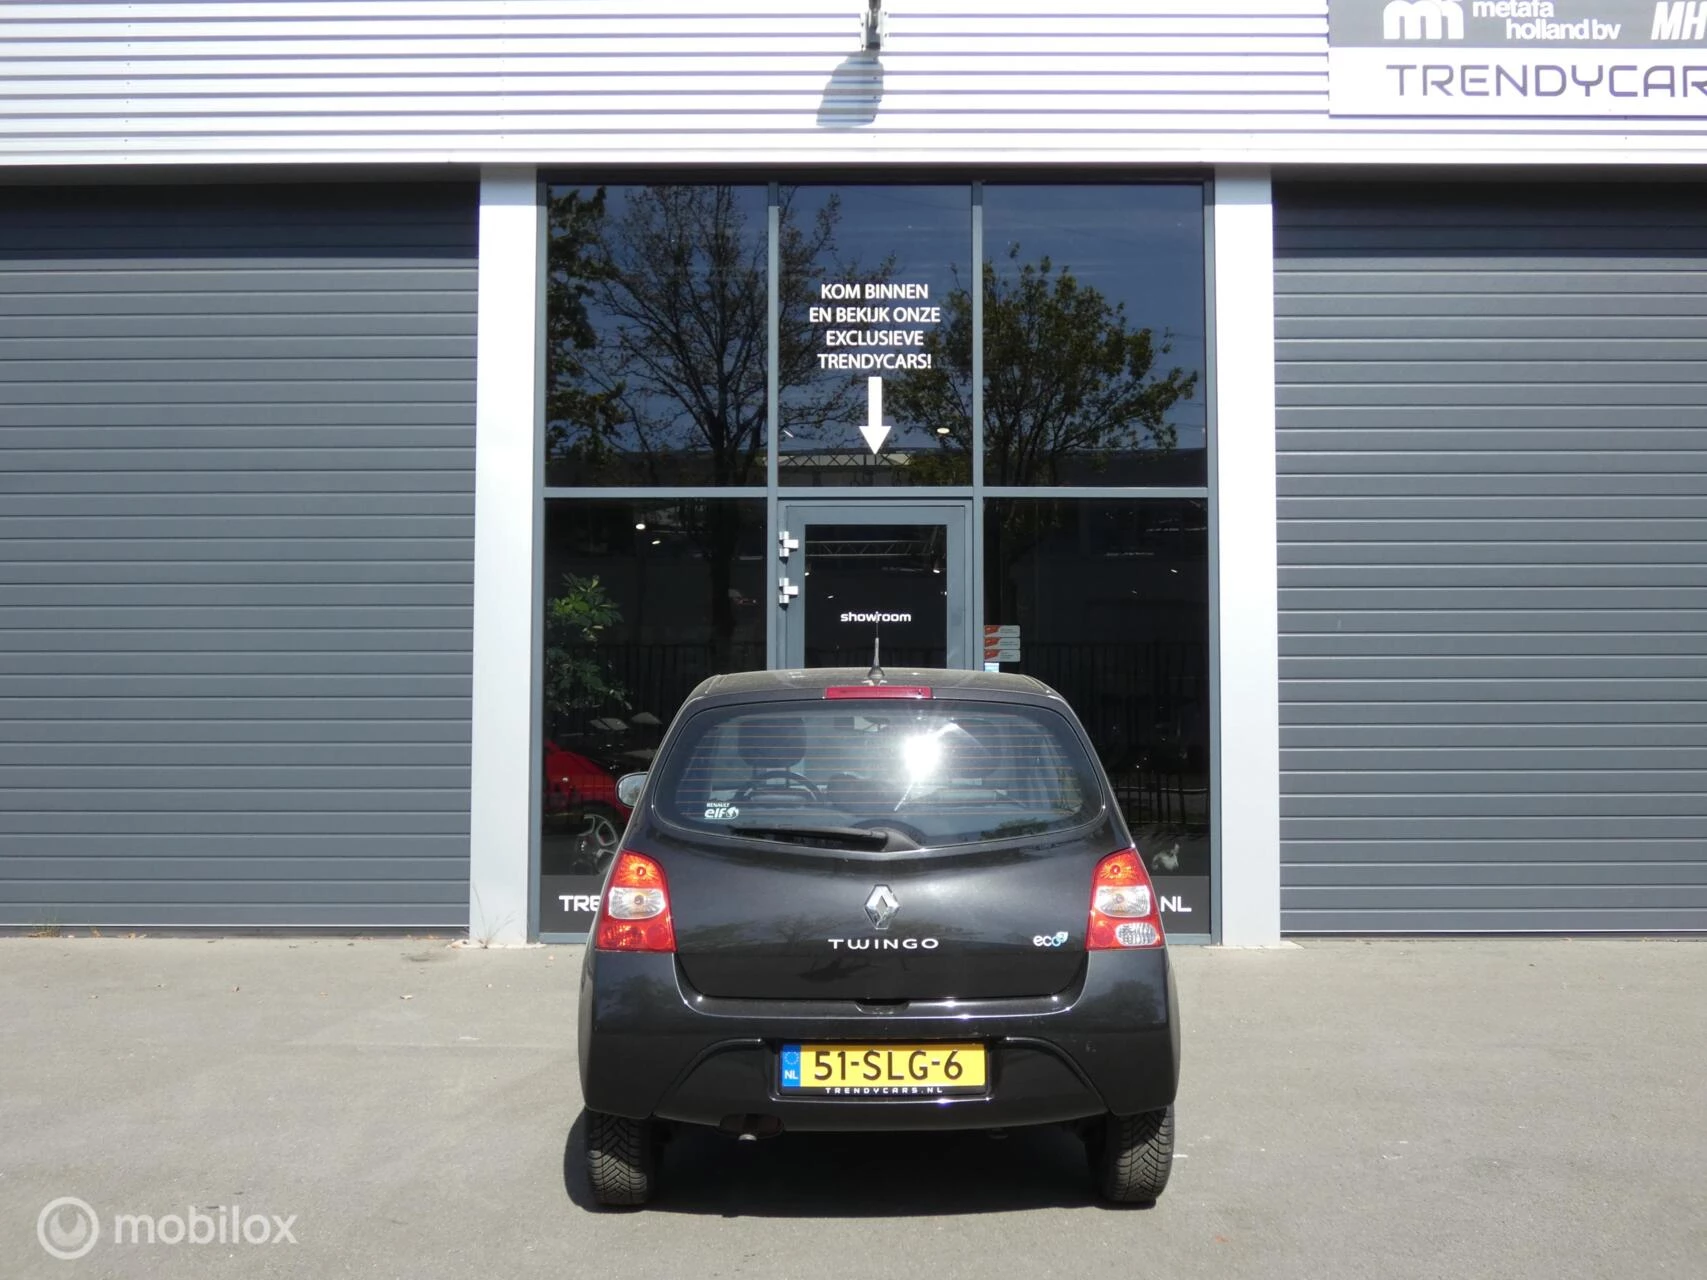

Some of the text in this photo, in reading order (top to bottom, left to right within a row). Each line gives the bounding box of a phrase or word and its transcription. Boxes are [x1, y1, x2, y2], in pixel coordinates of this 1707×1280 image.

[1472, 0, 1555, 18] metafa
[1651, 1, 1707, 40] MH
[1505, 19, 1622, 40] holland bv
[1386, 64, 1707, 97] TRENDYCAR
[821, 284, 928, 299] KOM BINNEN
[809, 307, 941, 322] EN BEKIJK ONZE
[826, 330, 924, 346] EXCLUSIEVE
[817, 353, 932, 369] TRENDYCARS!
[840, 611, 912, 622] showroom
[704, 808, 727, 818] elf
[1160, 896, 1192, 912] NL
[828, 938, 939, 950] TWINGO
[814, 1050, 963, 1081] 51-SLG-6
[784, 1070, 798, 1080] NL
